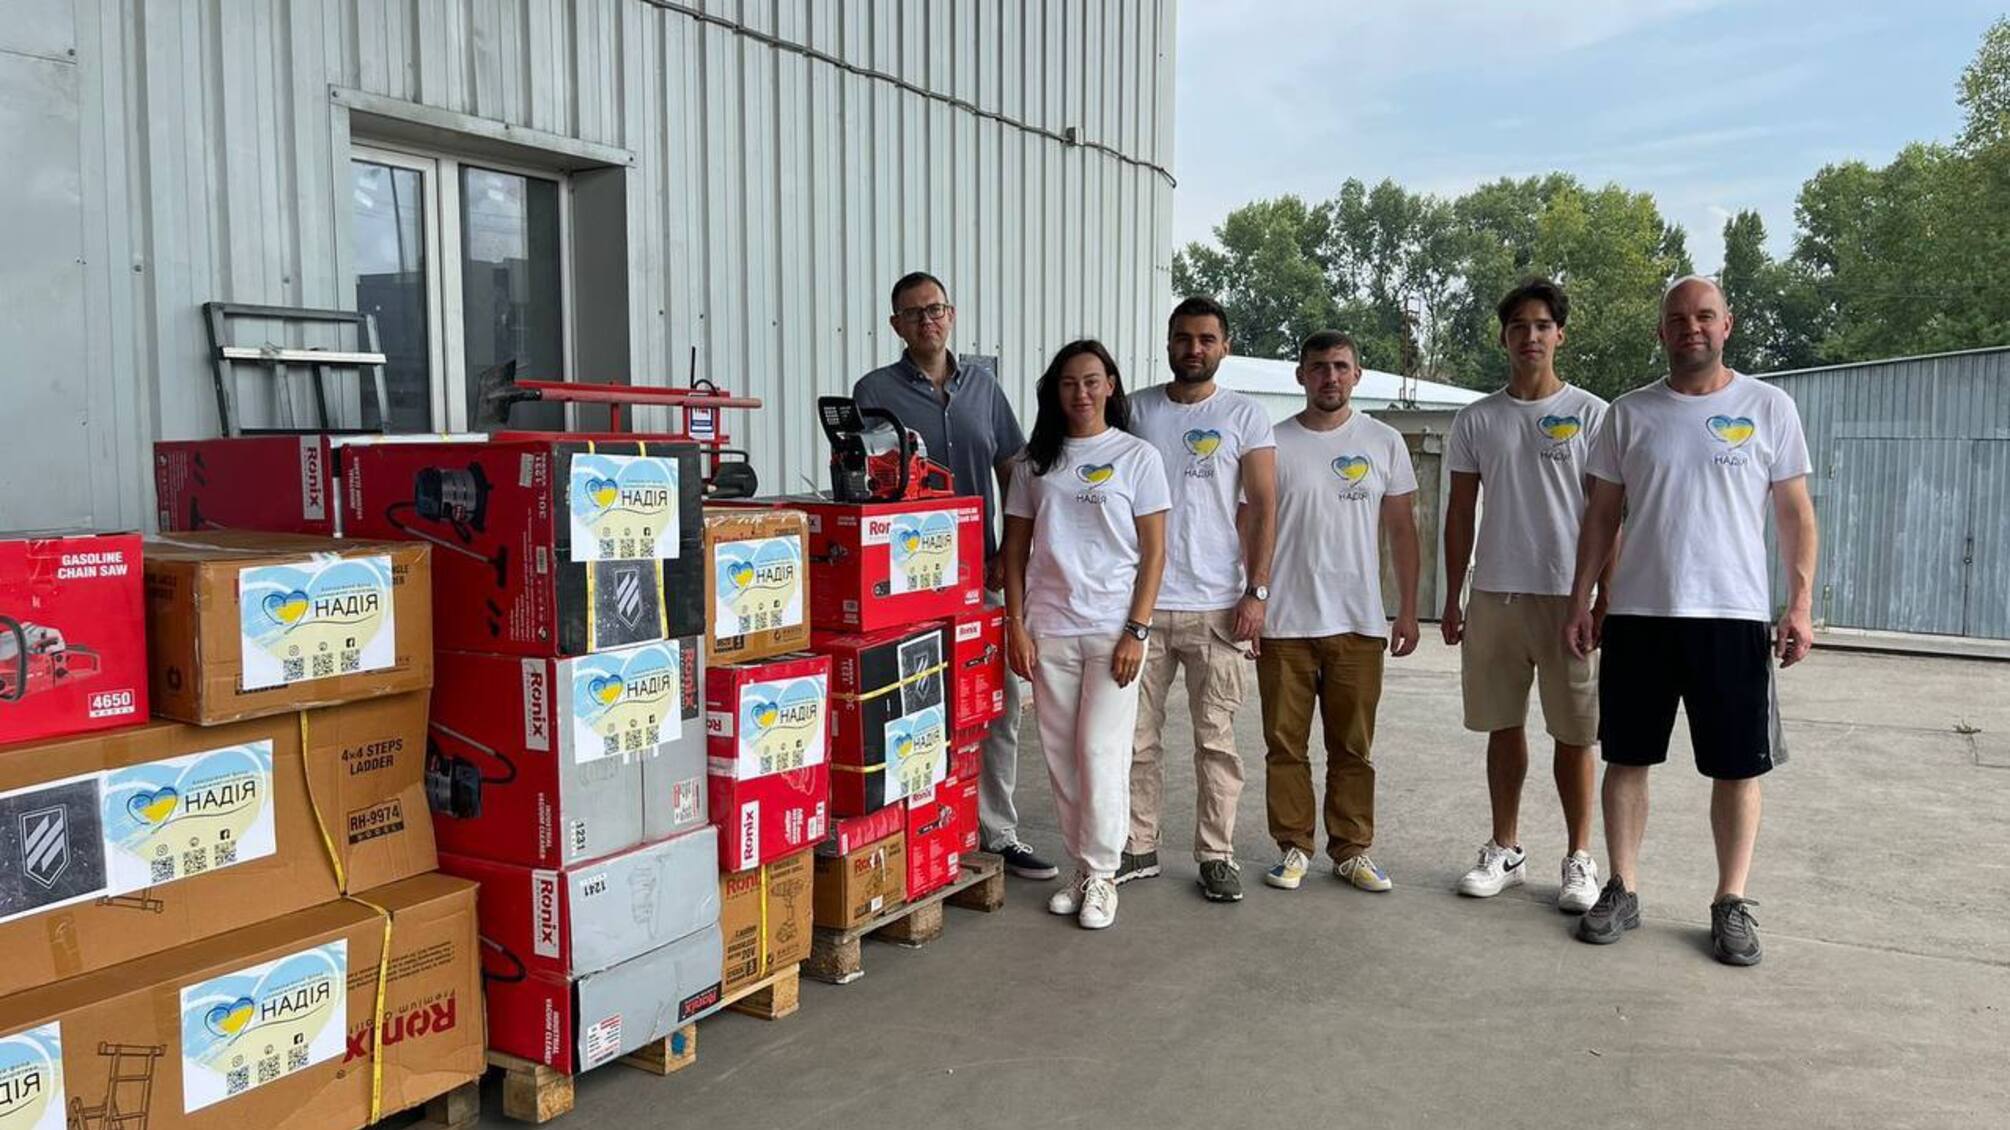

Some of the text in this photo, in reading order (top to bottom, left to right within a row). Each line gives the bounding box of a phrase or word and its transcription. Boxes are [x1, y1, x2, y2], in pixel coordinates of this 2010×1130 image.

[306, 447, 320, 507] Ronix
[621, 490, 667, 507] НАДІЯ
[921, 534, 951, 549] НАДІЯ
[62, 551, 123, 566] GASOLINE
[57, 564, 128, 579] CHAIN SAW
[756, 565, 793, 583] НАДІЯ
[315, 593, 378, 617] НАДІЯ
[627, 675, 670, 698] НАДІЯ
[92, 691, 131, 709] 4650
[531, 672, 545, 737] Ronix
[780, 704, 817, 723] НАДІЯ
[367, 738, 403, 757] STEPS
[350, 754, 394, 775] LADDER
[185, 780, 256, 813] НАДІЯ
[350, 805, 400, 831] RH-9974
[576, 822, 585, 850] 1231
[744, 810, 754, 861] Ronix
[727, 872, 761, 895] Roni
[541, 880, 556, 944] Ronix
[261, 981, 329, 1021] НАДІЯ
[342, 998, 456, 1064] Ronix
[0, 1072, 40, 1104] ДІЯ
